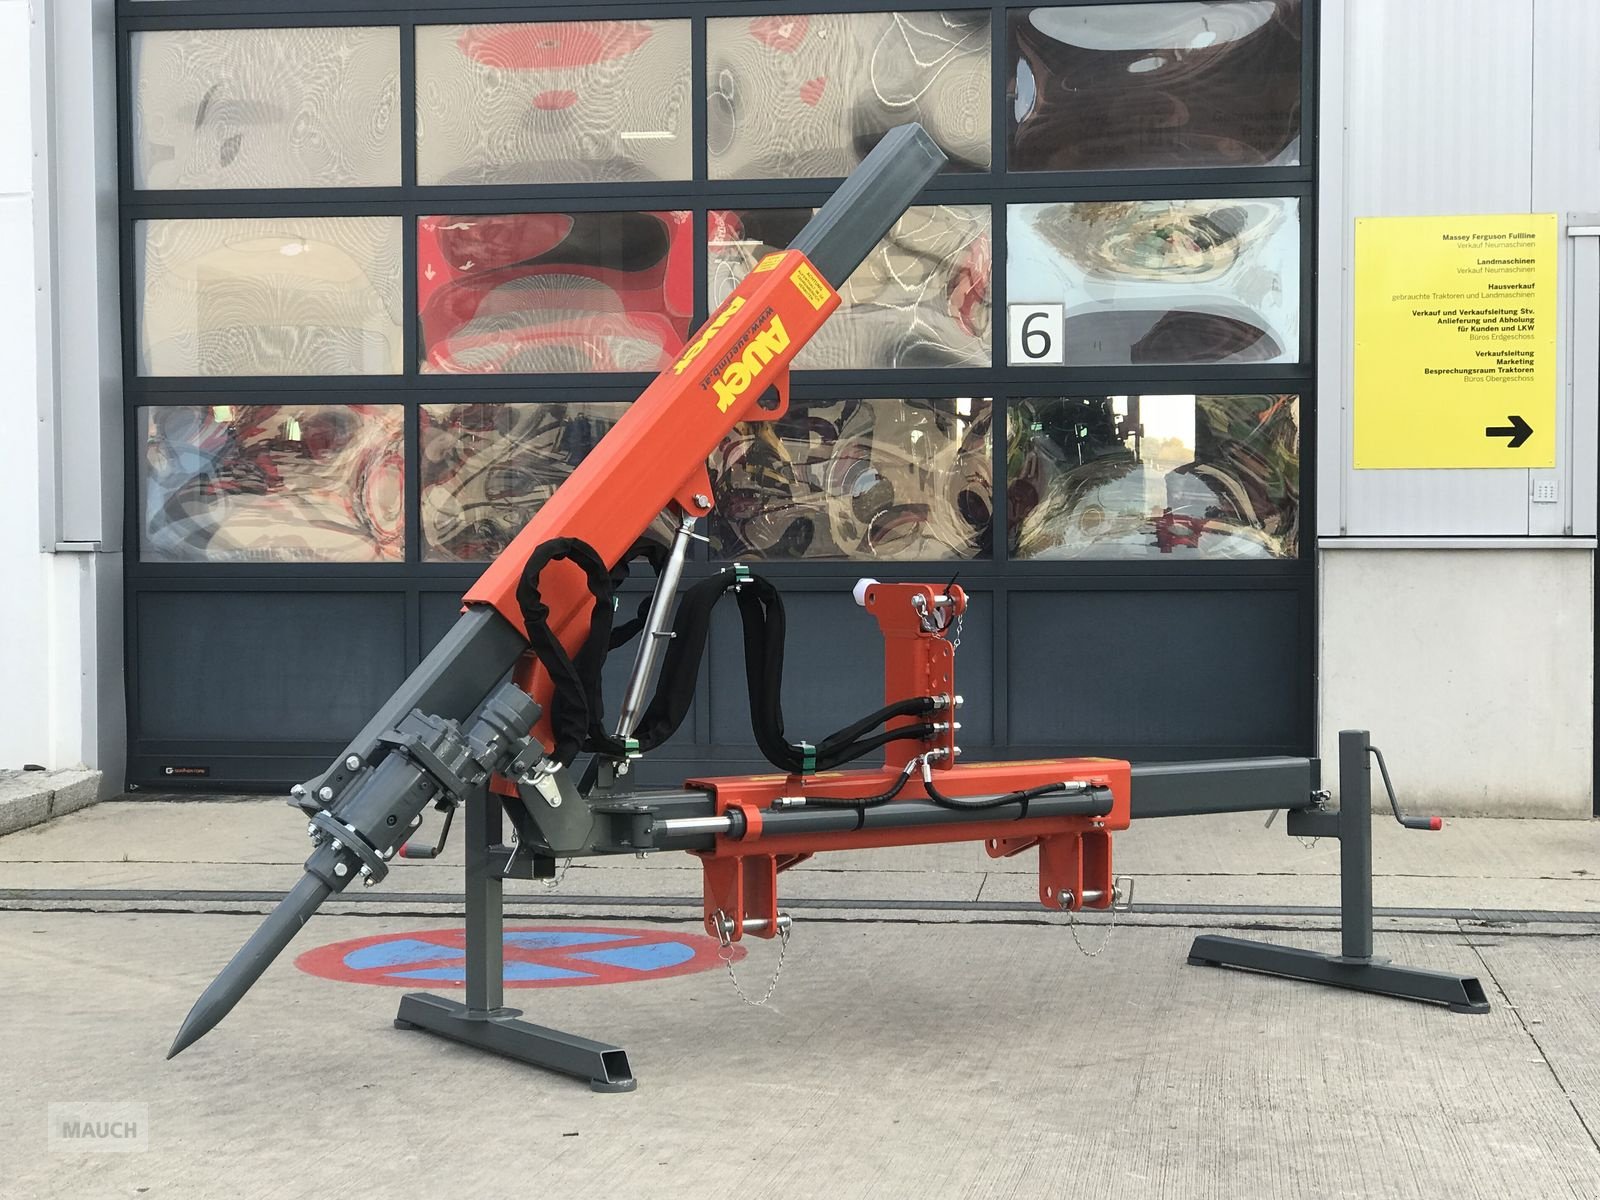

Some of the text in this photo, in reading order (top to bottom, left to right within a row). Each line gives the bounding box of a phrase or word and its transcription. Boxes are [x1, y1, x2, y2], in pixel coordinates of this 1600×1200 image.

[1442, 233, 1470, 242] Massey
[1472, 233, 1507, 241] Ferguson
[1457, 240, 1536, 249] Verkauf Neumaschinen
[1477, 257, 1535, 266] Landmaschinen
[1457, 265, 1536, 274] Verkauf Neumaschinen
[1488, 282, 1535, 290] Hausverkauf
[1391, 292, 1430, 302] gebrauchte
[1432, 292, 1465, 300] Traktoren
[1481, 291, 1535, 299] Landmaschinen
[1459, 308, 1518, 316] Verkaufsleitung
[1437, 317, 1481, 325] Anlieferung
[1499, 316, 1535, 324] Abholung
[1517, 324, 1535, 332] LKW
[673, 296, 746, 376] Auer
[1021, 312, 1051, 359] 6
[1469, 333, 1535, 341] Büros Erdgeschoss
[1475, 350, 1535, 358] Verkaufsleitung
[712, 314, 791, 414] Auer
[1496, 358, 1535, 366] Marketing
[1424, 366, 1535, 375] Besprechungsraum Traktoren
[1463, 375, 1534, 383] Büros Obergeschoss
